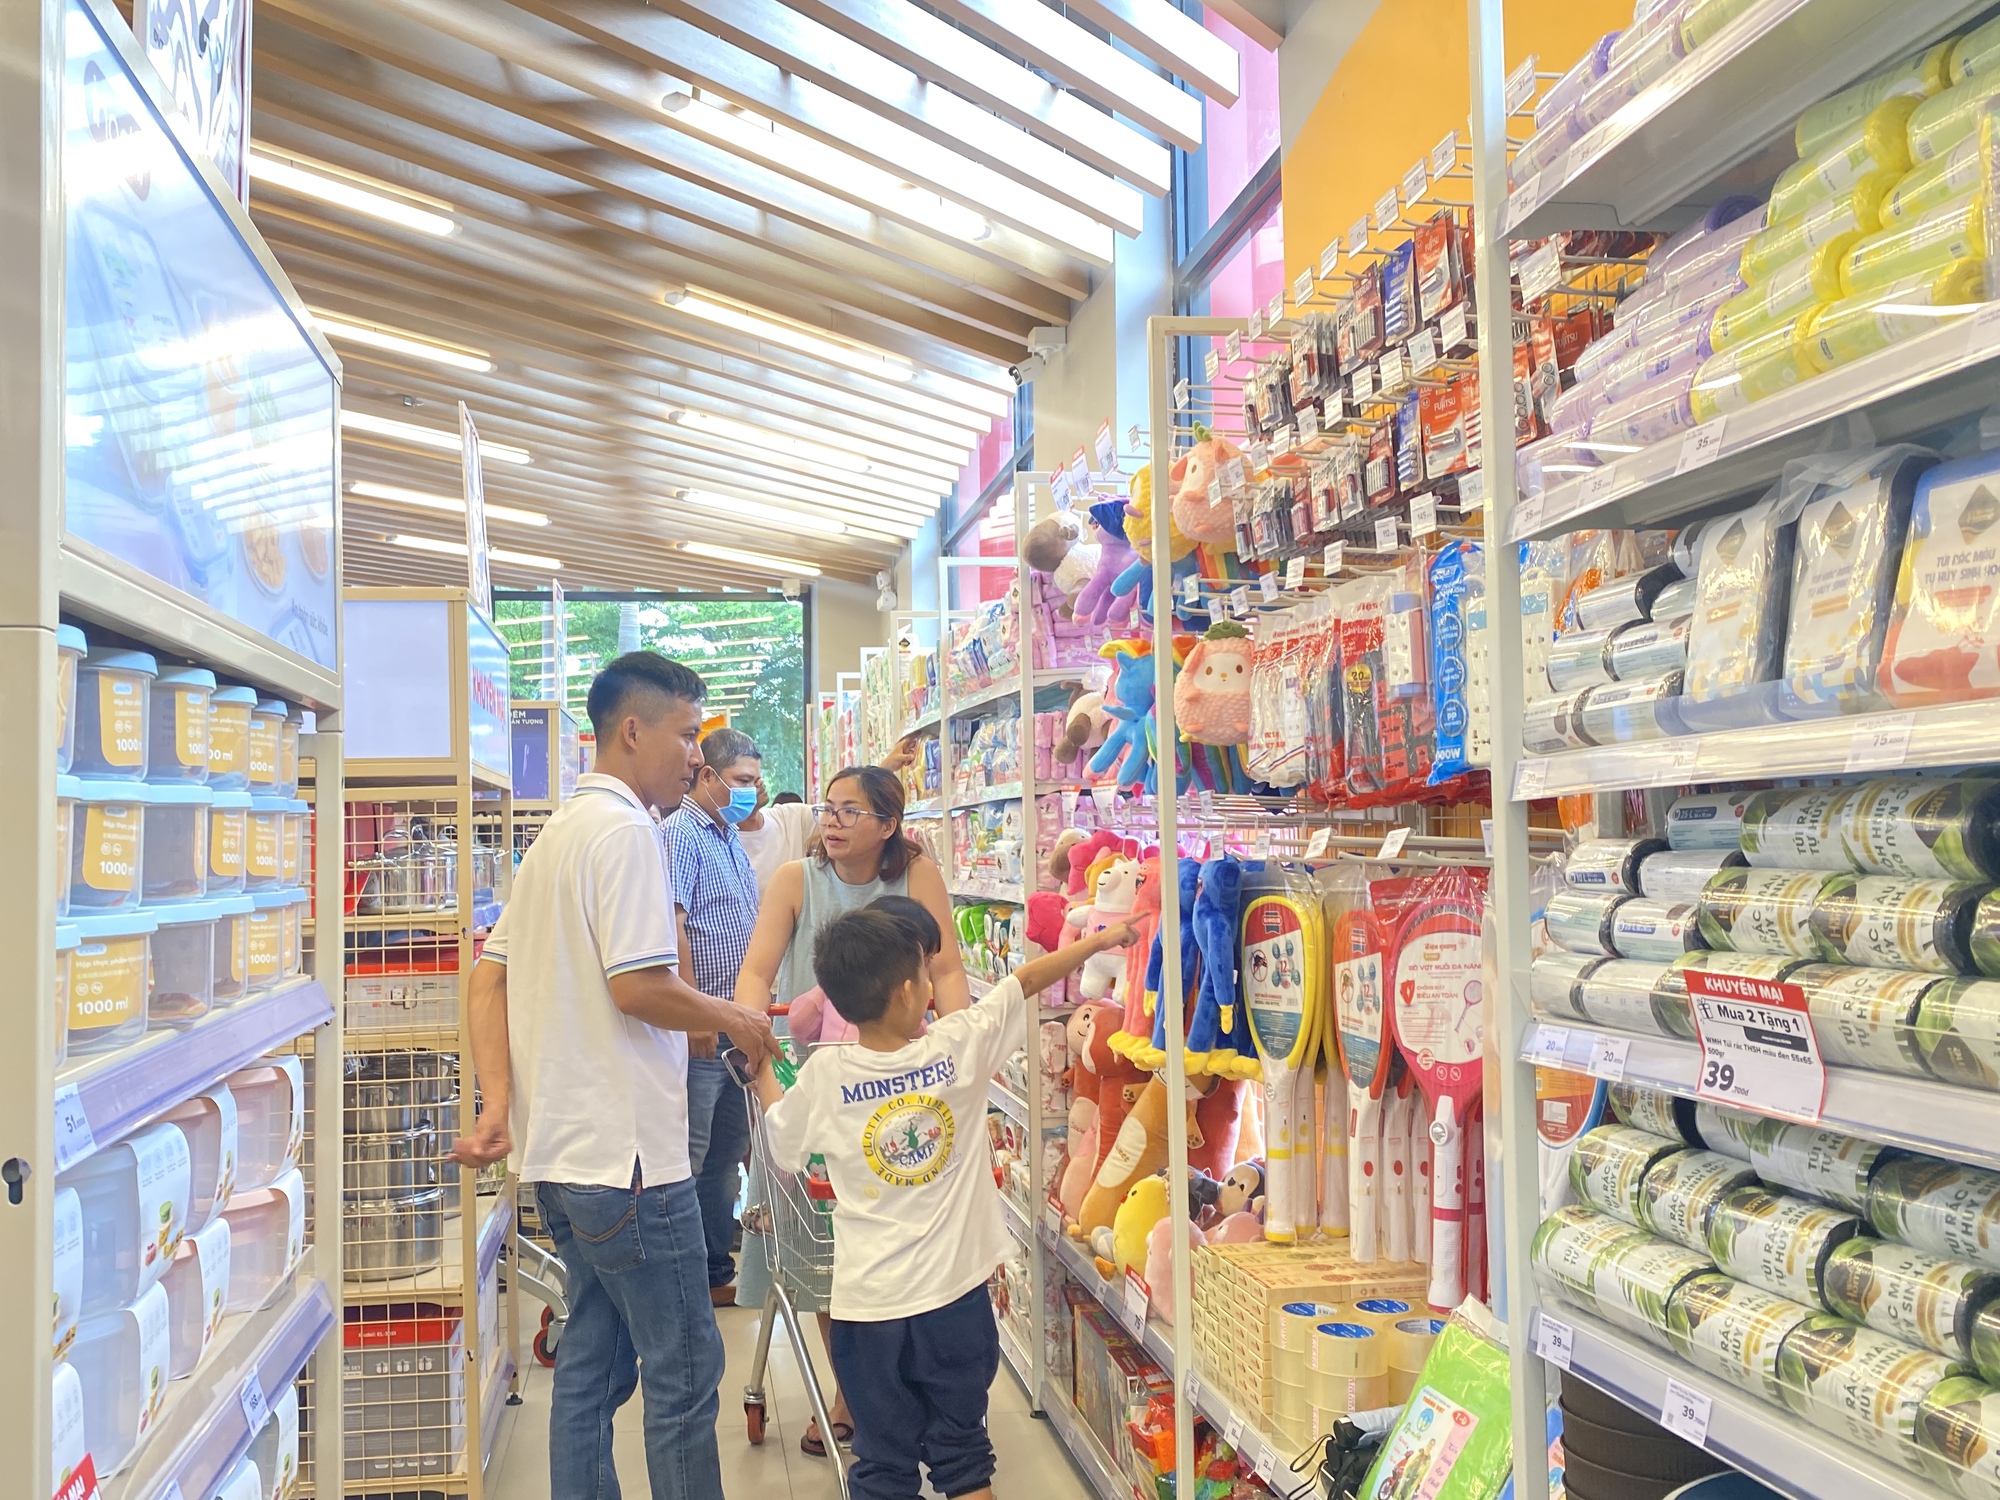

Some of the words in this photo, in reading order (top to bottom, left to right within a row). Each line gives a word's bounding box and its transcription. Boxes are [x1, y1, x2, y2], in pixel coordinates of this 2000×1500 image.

[1433, 395, 1456, 411] FUJITSU
[1695, 436, 1709, 451] 35
[1447, 712, 1457, 721] PP
[116, 738, 139, 752] 1000
[222, 750, 233, 761] ml
[1797, 794, 1821, 829] RÁC
[1872, 797, 1889, 839] SINH
[1792, 831, 1806, 855] TÚI
[1804, 836, 1820, 855] TỰ
[100, 861, 127, 875] 1000
[255, 855, 273, 866] 1000
[1868, 884, 1896, 922] MÀU
[250, 954, 271, 965] 1000
[1279, 959, 1288, 973] 12
[1703, 975, 1757, 998] KHUYẾN
[1758, 984, 1785, 1005] MẠI
[1843, 977, 1868, 1012] RÁC
[76, 999, 113, 1016] 1000
[116, 996, 129, 1012] ml
[1717, 1004, 1745, 1022] Mua
[1746, 1009, 1756, 1023] 2
[1760, 1011, 1790, 1034] Tặng
[1792, 1017, 1801, 1032] 1
[1838, 1018, 1856, 1046] TÚI
[1855, 1026, 1871, 1048] TỰ
[1545, 1040, 1556, 1051] 20
[1603, 1050, 1614, 1062] 20
[1705, 1035, 1722, 1045] WMH
[1722, 1038, 1731, 1048] Túi
[1732, 1040, 1743, 1051] rác
[1762, 1045, 1777, 1058] màu
[1777, 1048, 1790, 1060] đen
[1707, 1047, 1725, 1059] 500gr
[841, 1054, 956, 1104] MONSTERS
[888, 1097, 911, 1110] CO.
[864, 1113, 883, 1157] CLOTH
[941, 1110, 956, 1148] LIVES
[899, 1143, 936, 1167] CAMP
[1807, 1145, 1822, 1170] TÚI
[1821, 1154, 1836, 1174] TỰ
[875, 1167, 916, 1187] MADE
[1945, 1189, 1969, 1226] RÁC
[1563, 1244, 1575, 1263] TÚI
[1944, 1230, 1965, 1256] TÚI
[1961, 1239, 1982, 1260] TỰ
[1761, 1258, 1775, 1283] TÚI
[1772, 1266, 1787, 1288] TỰ
[1551, 1335, 1562, 1348] 39
[1718, 1315, 1735, 1352] RÁC
[1843, 1368, 1863, 1410] RÁC
[1682, 1405, 1694, 1420] 39
